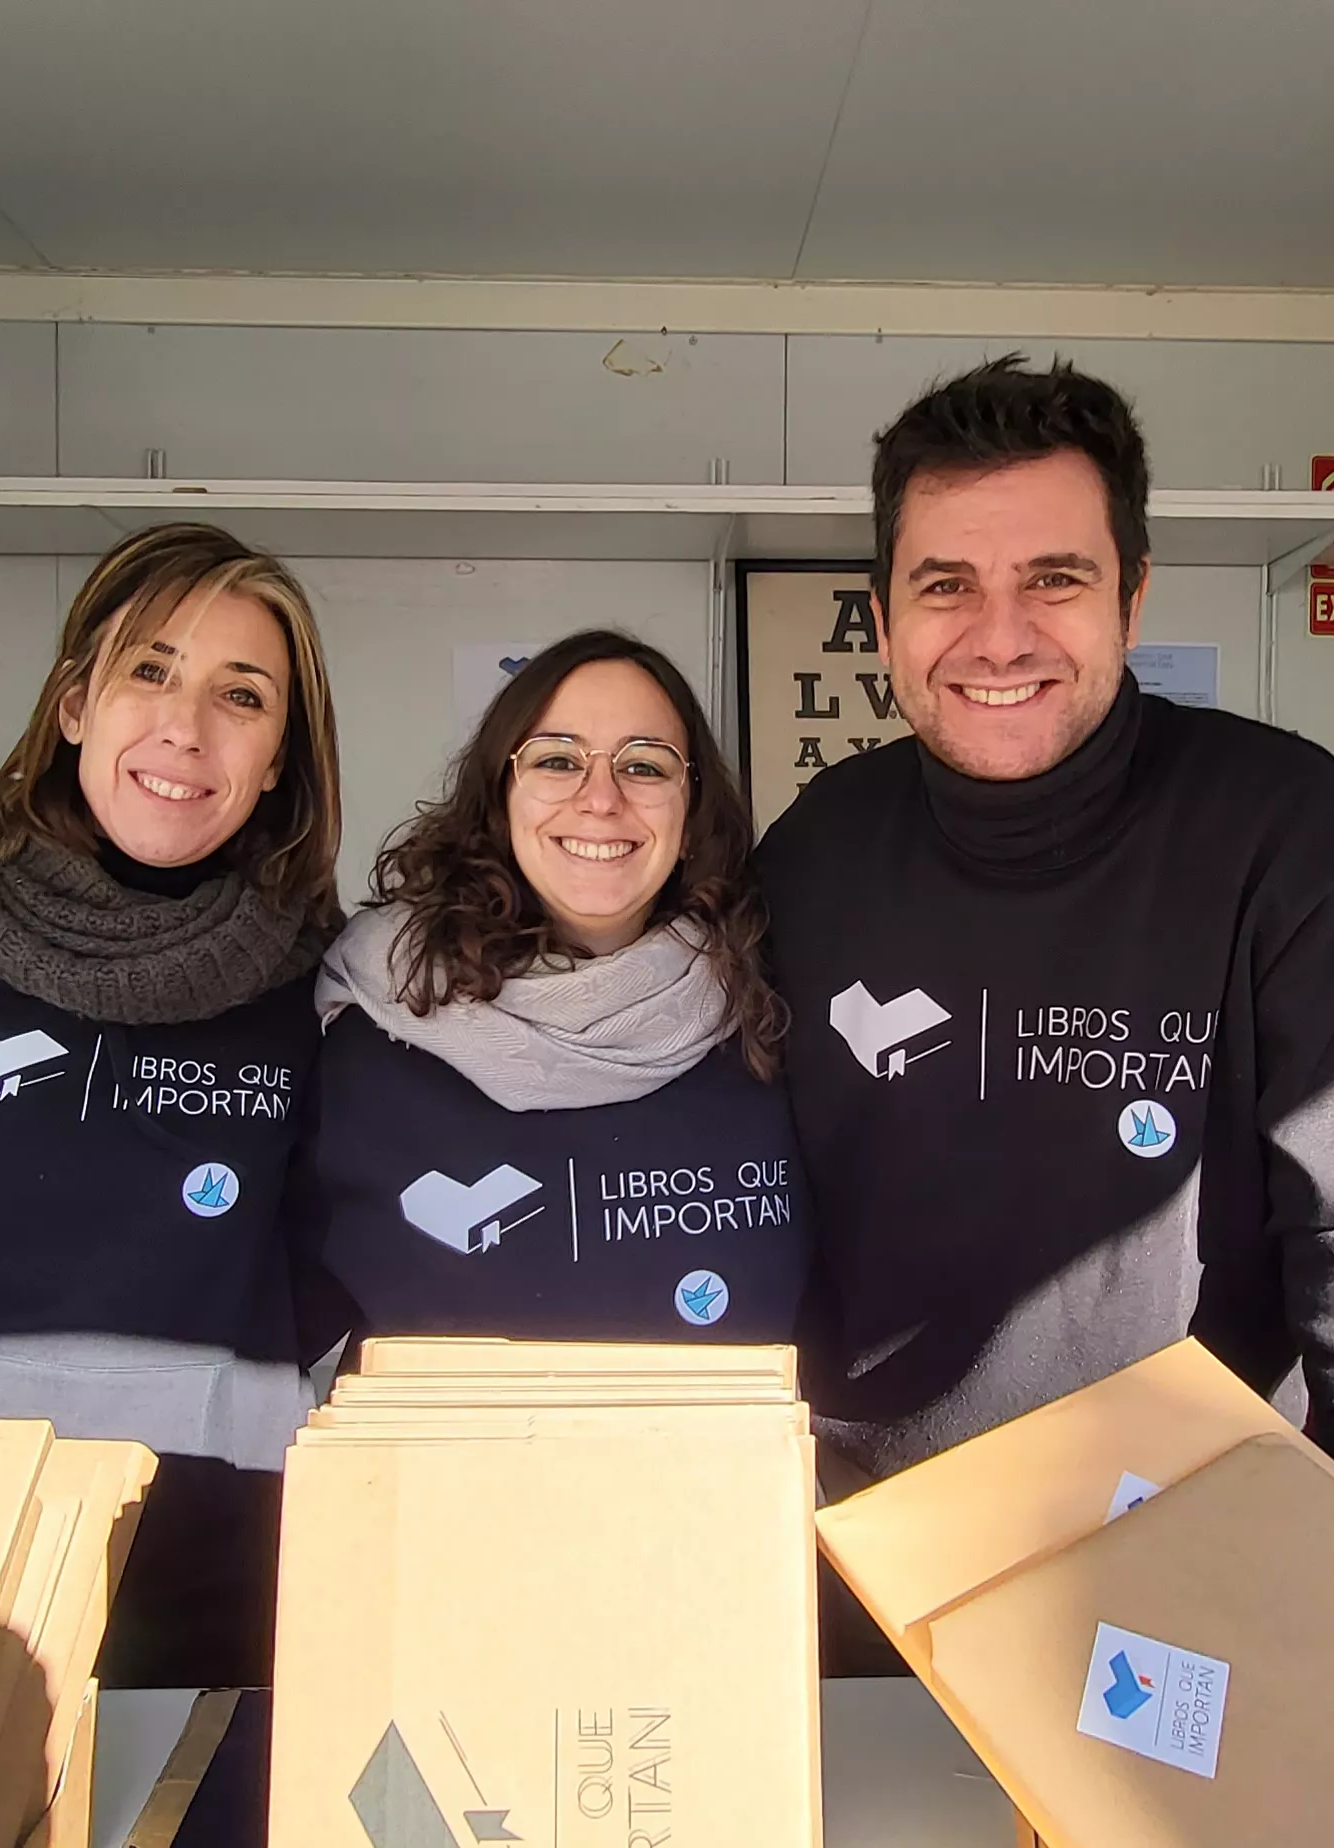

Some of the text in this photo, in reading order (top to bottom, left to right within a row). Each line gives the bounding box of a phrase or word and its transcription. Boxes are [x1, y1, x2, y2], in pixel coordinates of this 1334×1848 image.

[1016, 1006, 1220, 1044] LIBROS QU
[238, 1064, 292, 1090] QUE
[600, 1159, 789, 1201] LIBROS QUE
[603, 1193, 791, 1242] IMPORTAN
[1170, 1659, 1195, 1751] LIBROS QUE
[1188, 1665, 1215, 1757] IMPORTAN
[577, 1707, 613, 1819] QUE
